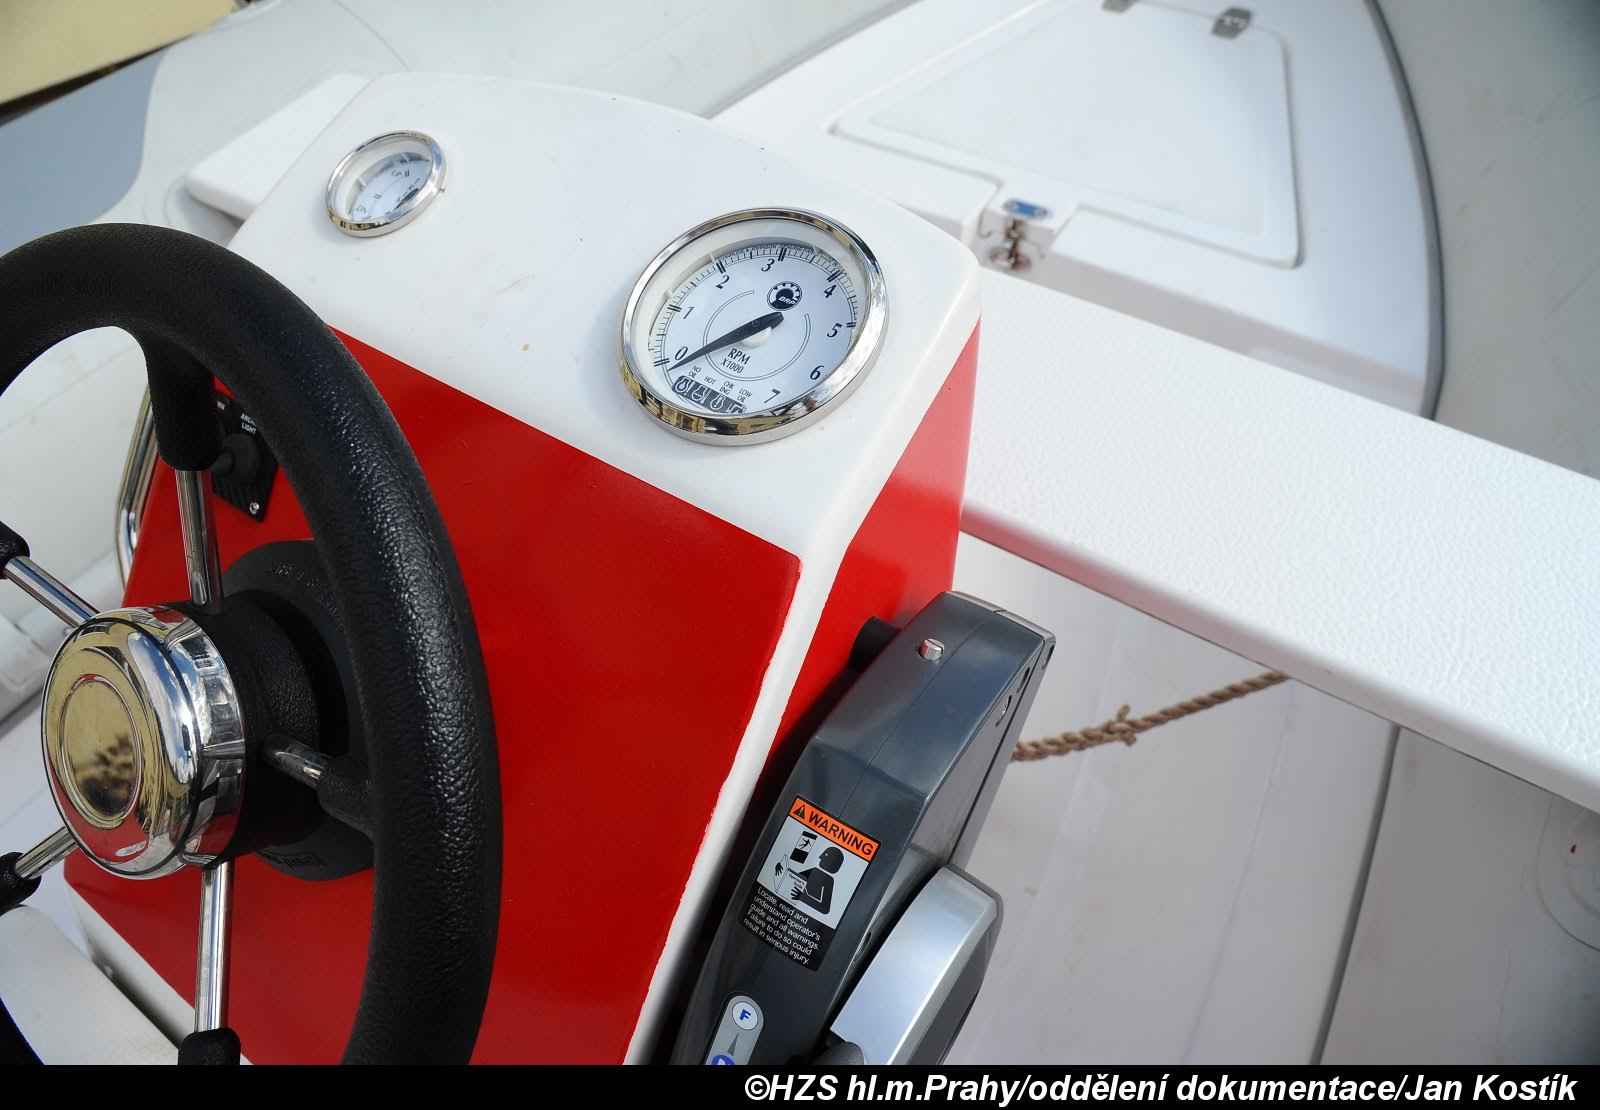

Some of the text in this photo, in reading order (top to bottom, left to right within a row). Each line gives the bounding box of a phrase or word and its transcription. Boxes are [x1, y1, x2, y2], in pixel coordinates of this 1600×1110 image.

[761, 258, 775, 272] 3
[716, 275, 729, 289] 2
[823, 285, 837, 299] 4
[778, 296, 797, 305] BRP
[683, 306, 695, 319] 1
[827, 322, 842, 338] 5
[674, 346, 688, 360] 0
[727, 348, 751, 365] RPM
[692, 365, 702, 373] NO
[720, 357, 744, 374] X1000
[810, 365, 824, 381] 6
[704, 376, 717, 385] HOT
[720, 386, 731, 395] ENG
[739, 388, 752, 398] LOW
[763, 388, 781, 403] 7
[240, 413, 257, 427] ANC
[241, 422, 257, 435] LIGHT
[809, 810, 874, 856] WARNING
[757, 887, 809, 924] Locate, read and
[754, 896, 820, 941] understand operator's
[747, 909, 813, 956] Failure to do so could
[750, 904, 819, 951] guide and all warnings.
[743, 918, 810, 965] result in serious injury.
[739, 1008, 752, 1021] F
